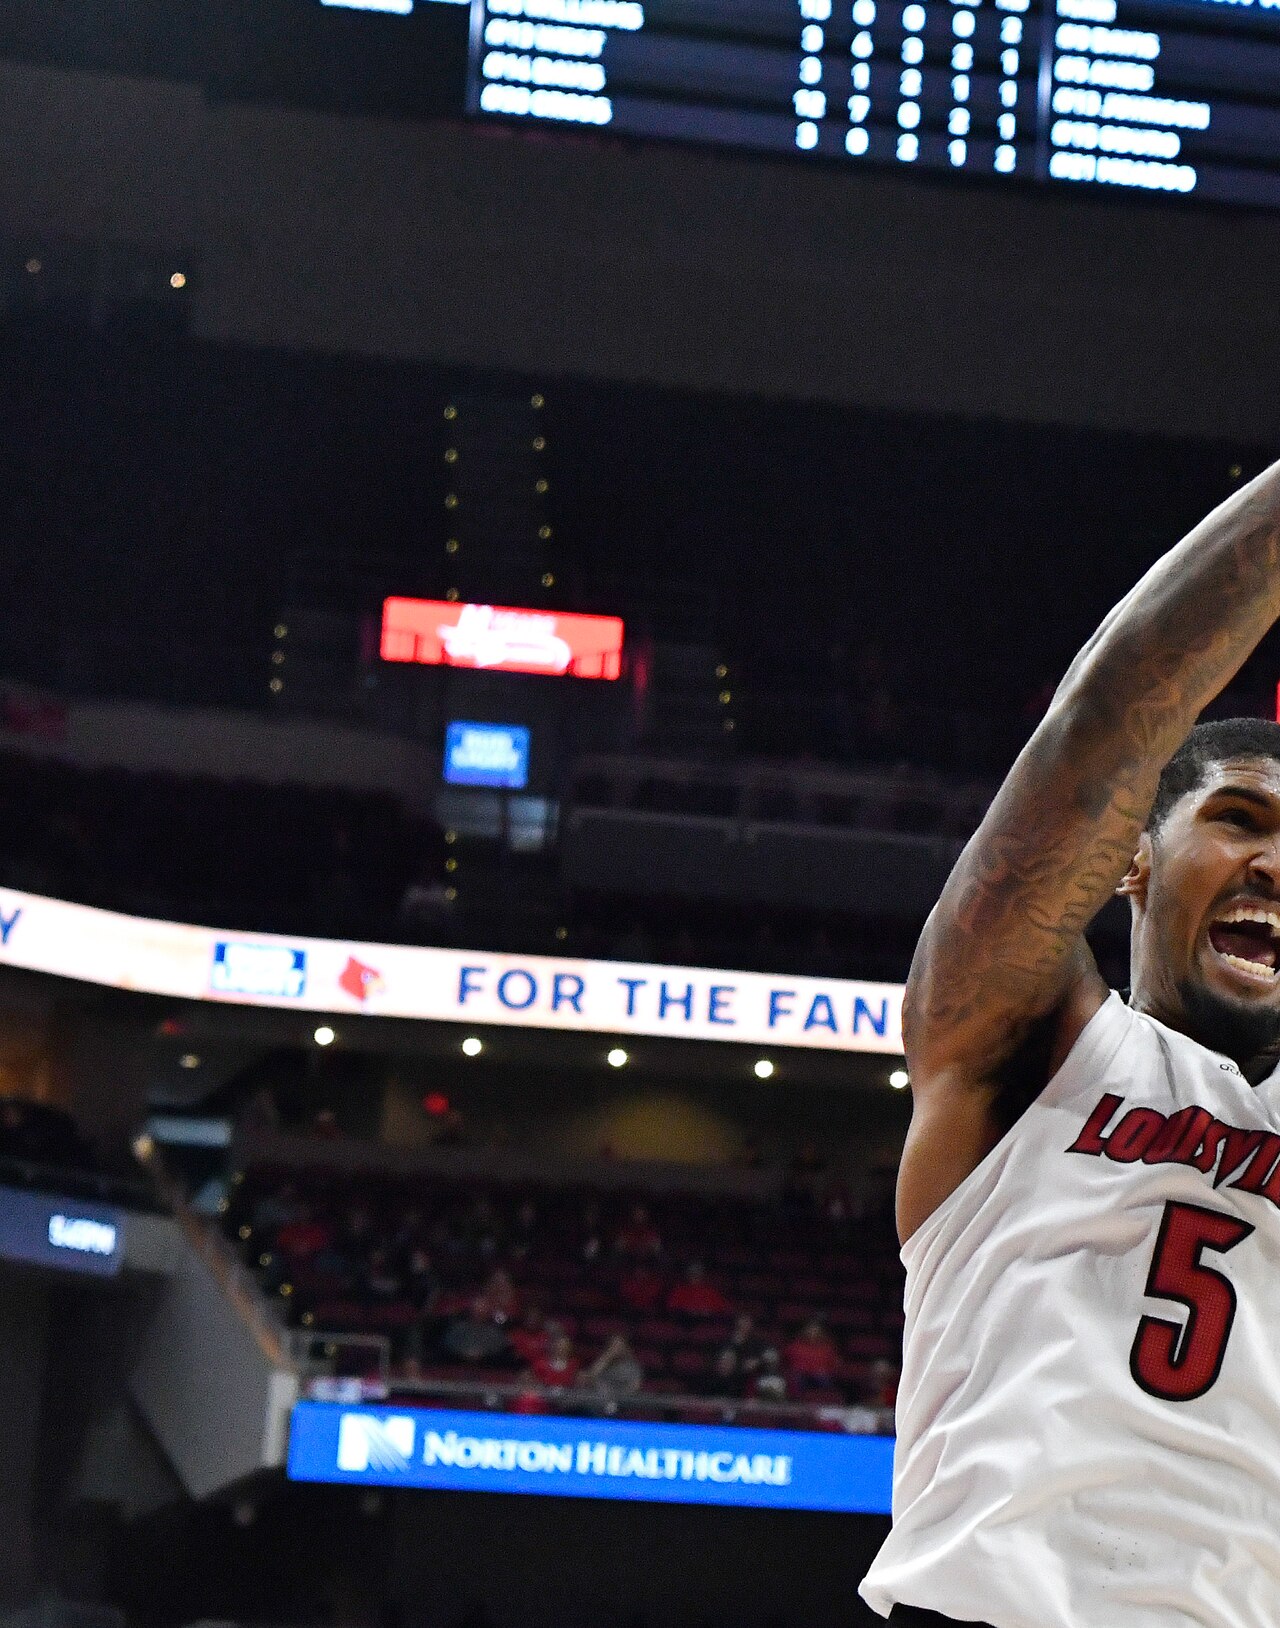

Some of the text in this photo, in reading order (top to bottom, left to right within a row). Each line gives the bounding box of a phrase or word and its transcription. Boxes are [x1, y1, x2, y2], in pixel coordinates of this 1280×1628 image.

[457, 966, 888, 1037] FOR THE FAN
[1129, 1199, 1256, 1402] 5
